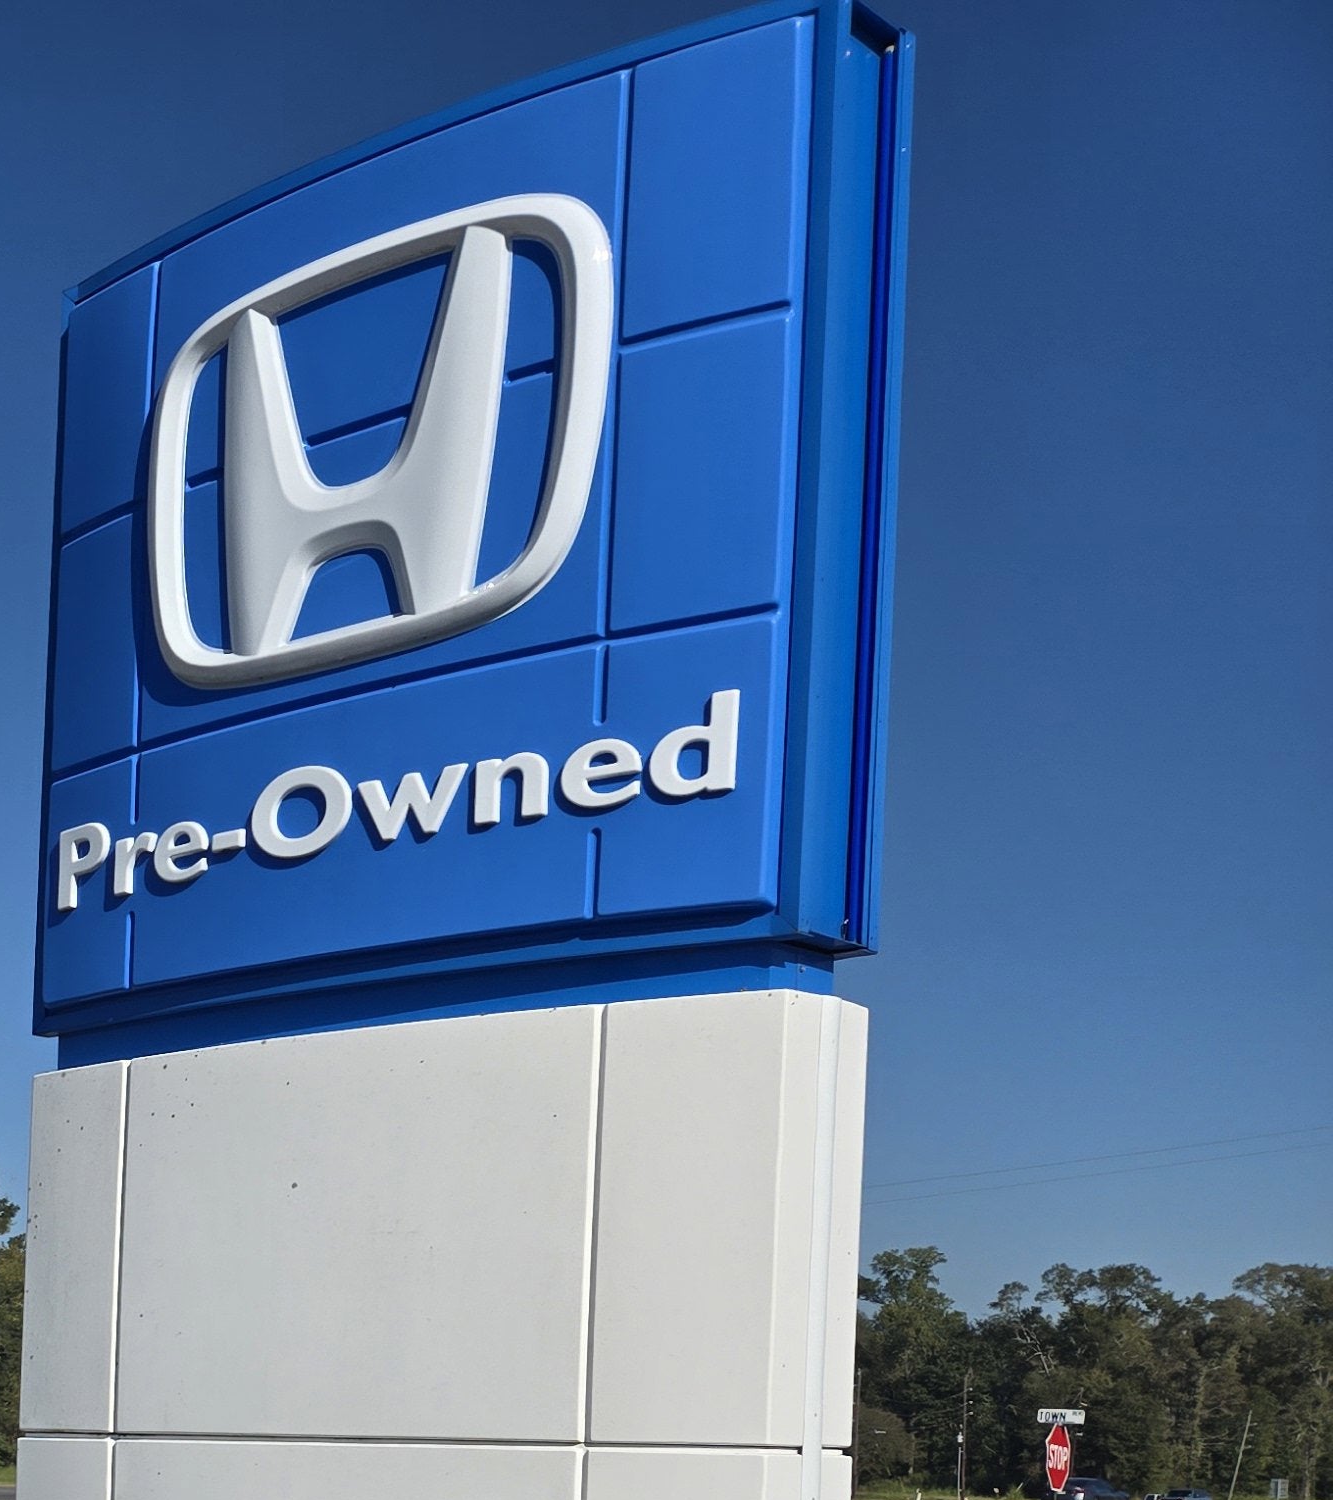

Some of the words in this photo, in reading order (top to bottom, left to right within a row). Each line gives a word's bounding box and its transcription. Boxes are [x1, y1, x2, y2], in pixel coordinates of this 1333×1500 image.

[58, 688, 741, 910] Pre-Owned
[1038, 1411, 1067, 1422] TOWN
[1049, 1444, 1068, 1470] STOP
